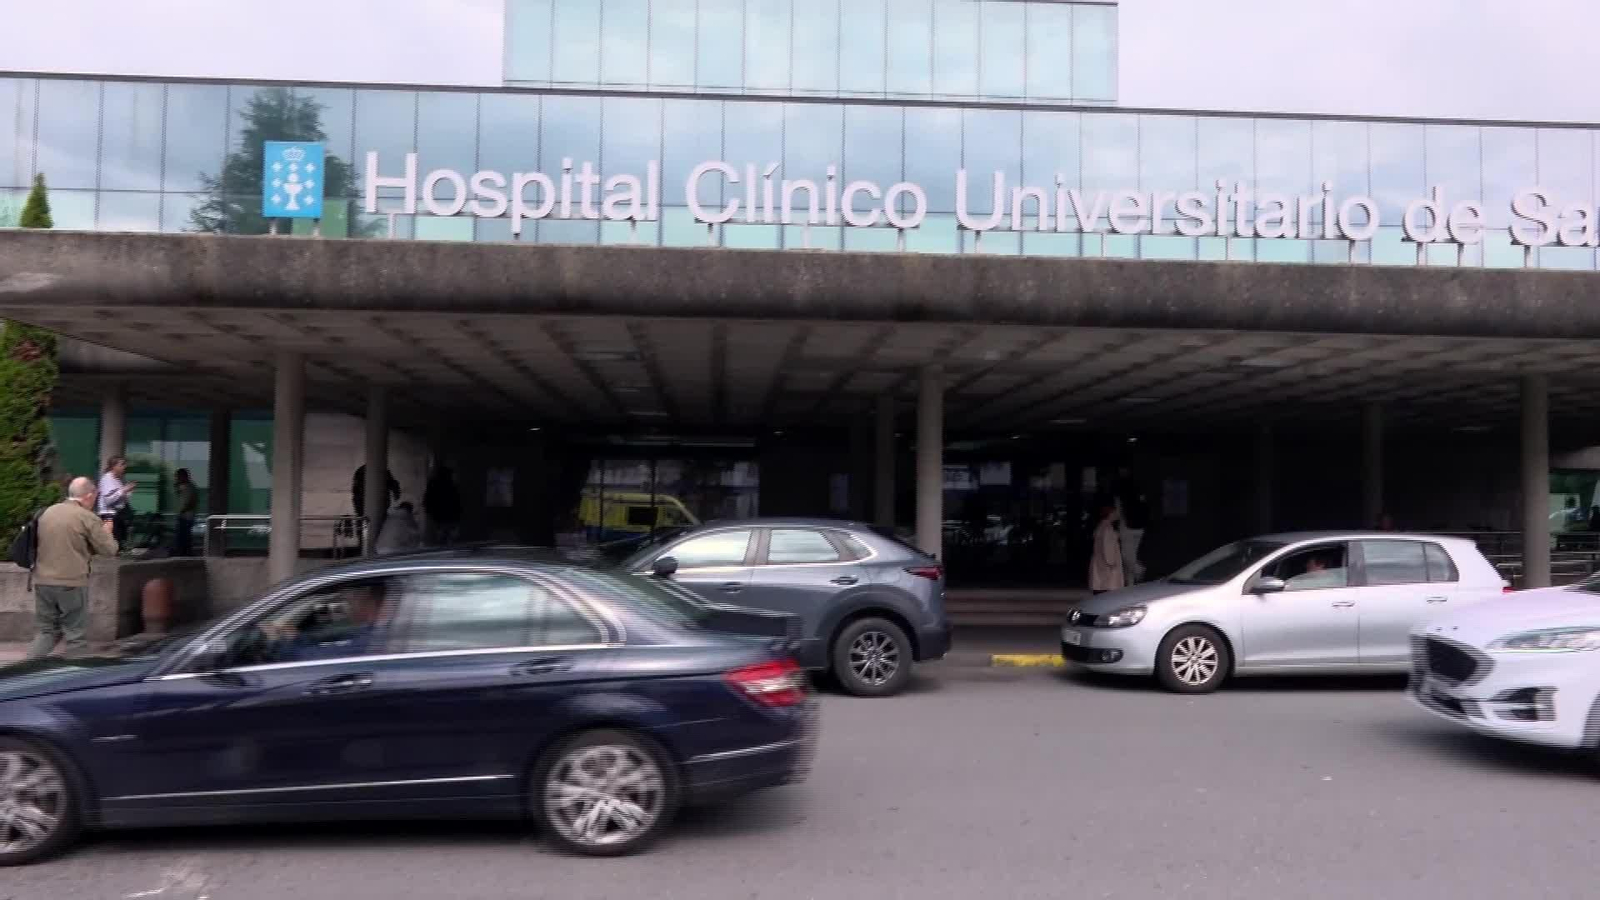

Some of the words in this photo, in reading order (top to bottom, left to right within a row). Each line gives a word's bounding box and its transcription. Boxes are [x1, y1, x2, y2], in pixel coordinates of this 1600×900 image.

[365, 151, 659, 232] Hospital
[685, 161, 927, 230] Clínico
[955, 168, 1381, 242] Universitario
[1403, 185, 1485, 244] de
